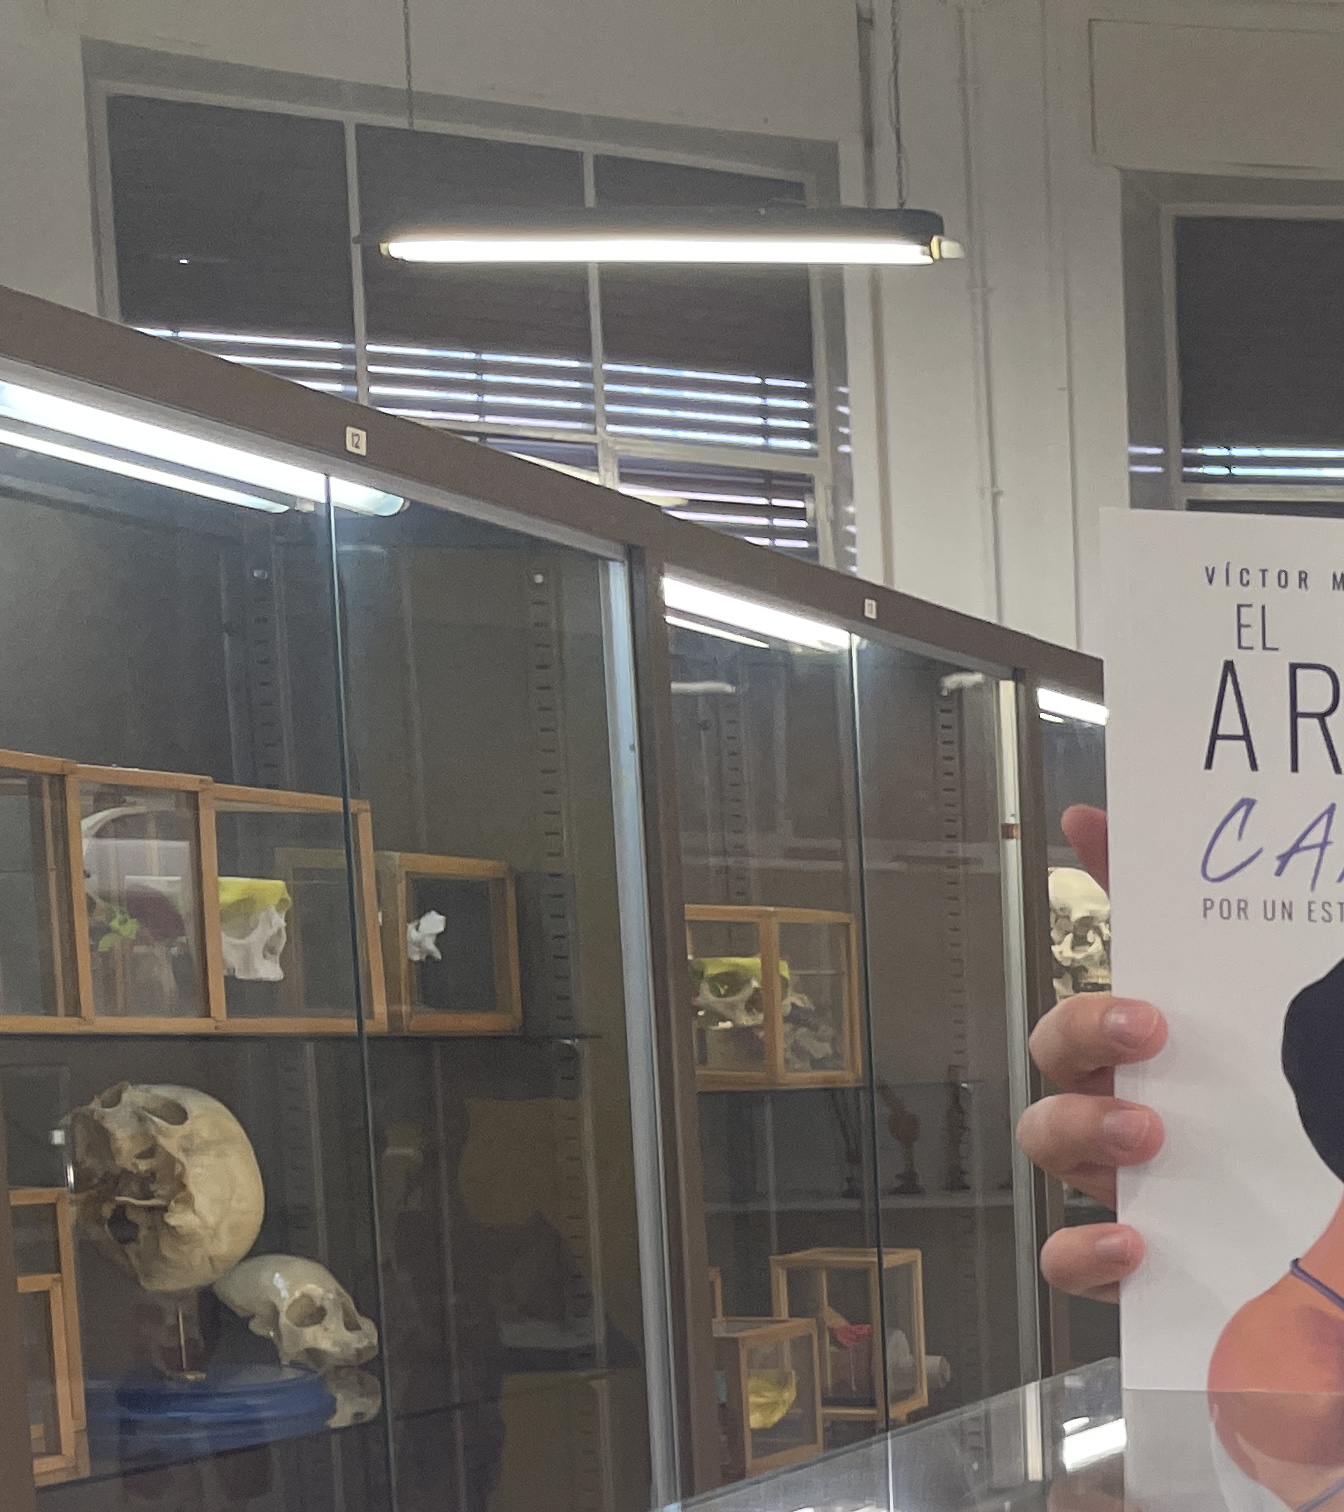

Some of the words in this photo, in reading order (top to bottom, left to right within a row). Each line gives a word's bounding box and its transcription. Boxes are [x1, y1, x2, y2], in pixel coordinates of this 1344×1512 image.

[351, 432, 361, 450] 12
[1204, 561, 1309, 591] VÍCTOR
[1236, 603, 1279, 651] EL
[1202, 897, 1250, 921] POR
[1263, 899, 1294, 922] UN
